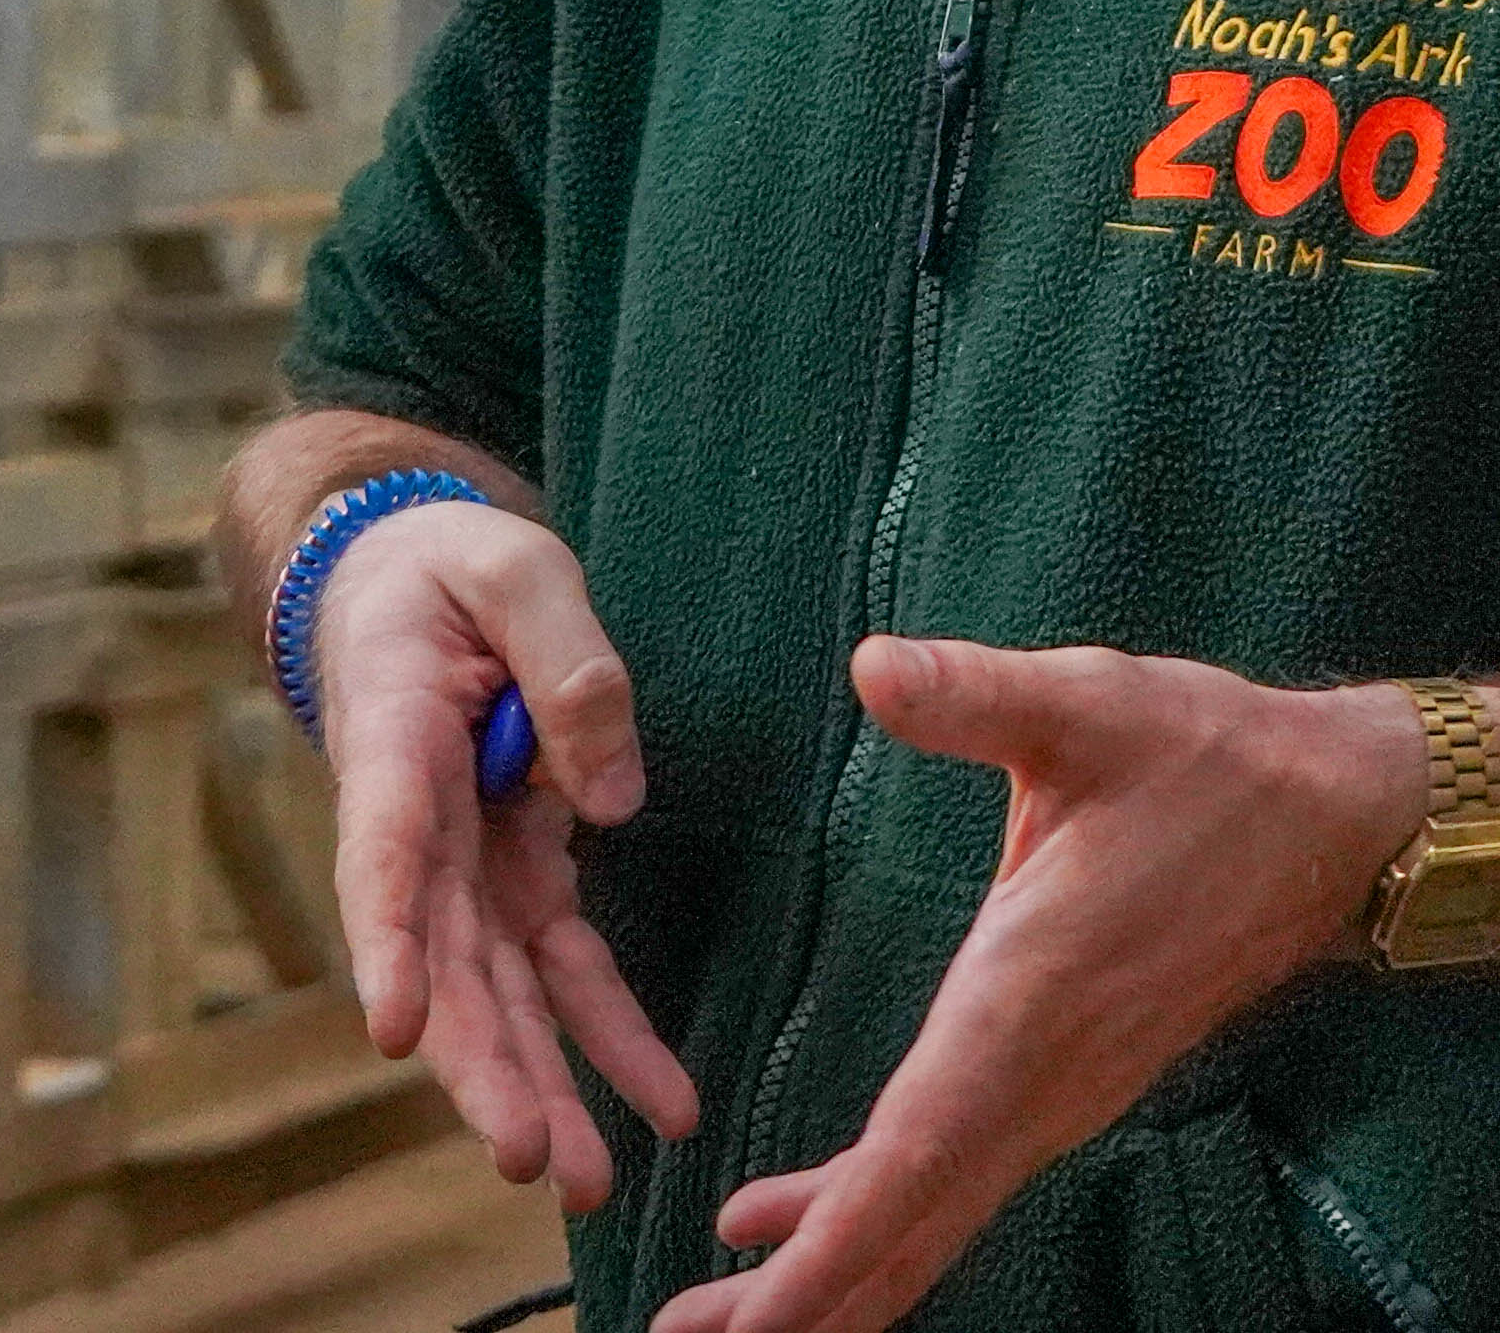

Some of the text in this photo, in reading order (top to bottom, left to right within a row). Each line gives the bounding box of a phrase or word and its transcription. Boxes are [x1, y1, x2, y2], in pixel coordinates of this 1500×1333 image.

[1358, 24, 1472, 85] Ark
[1133, 71, 1447, 237] ZOO
[1192, 225, 1325, 277] FARM
